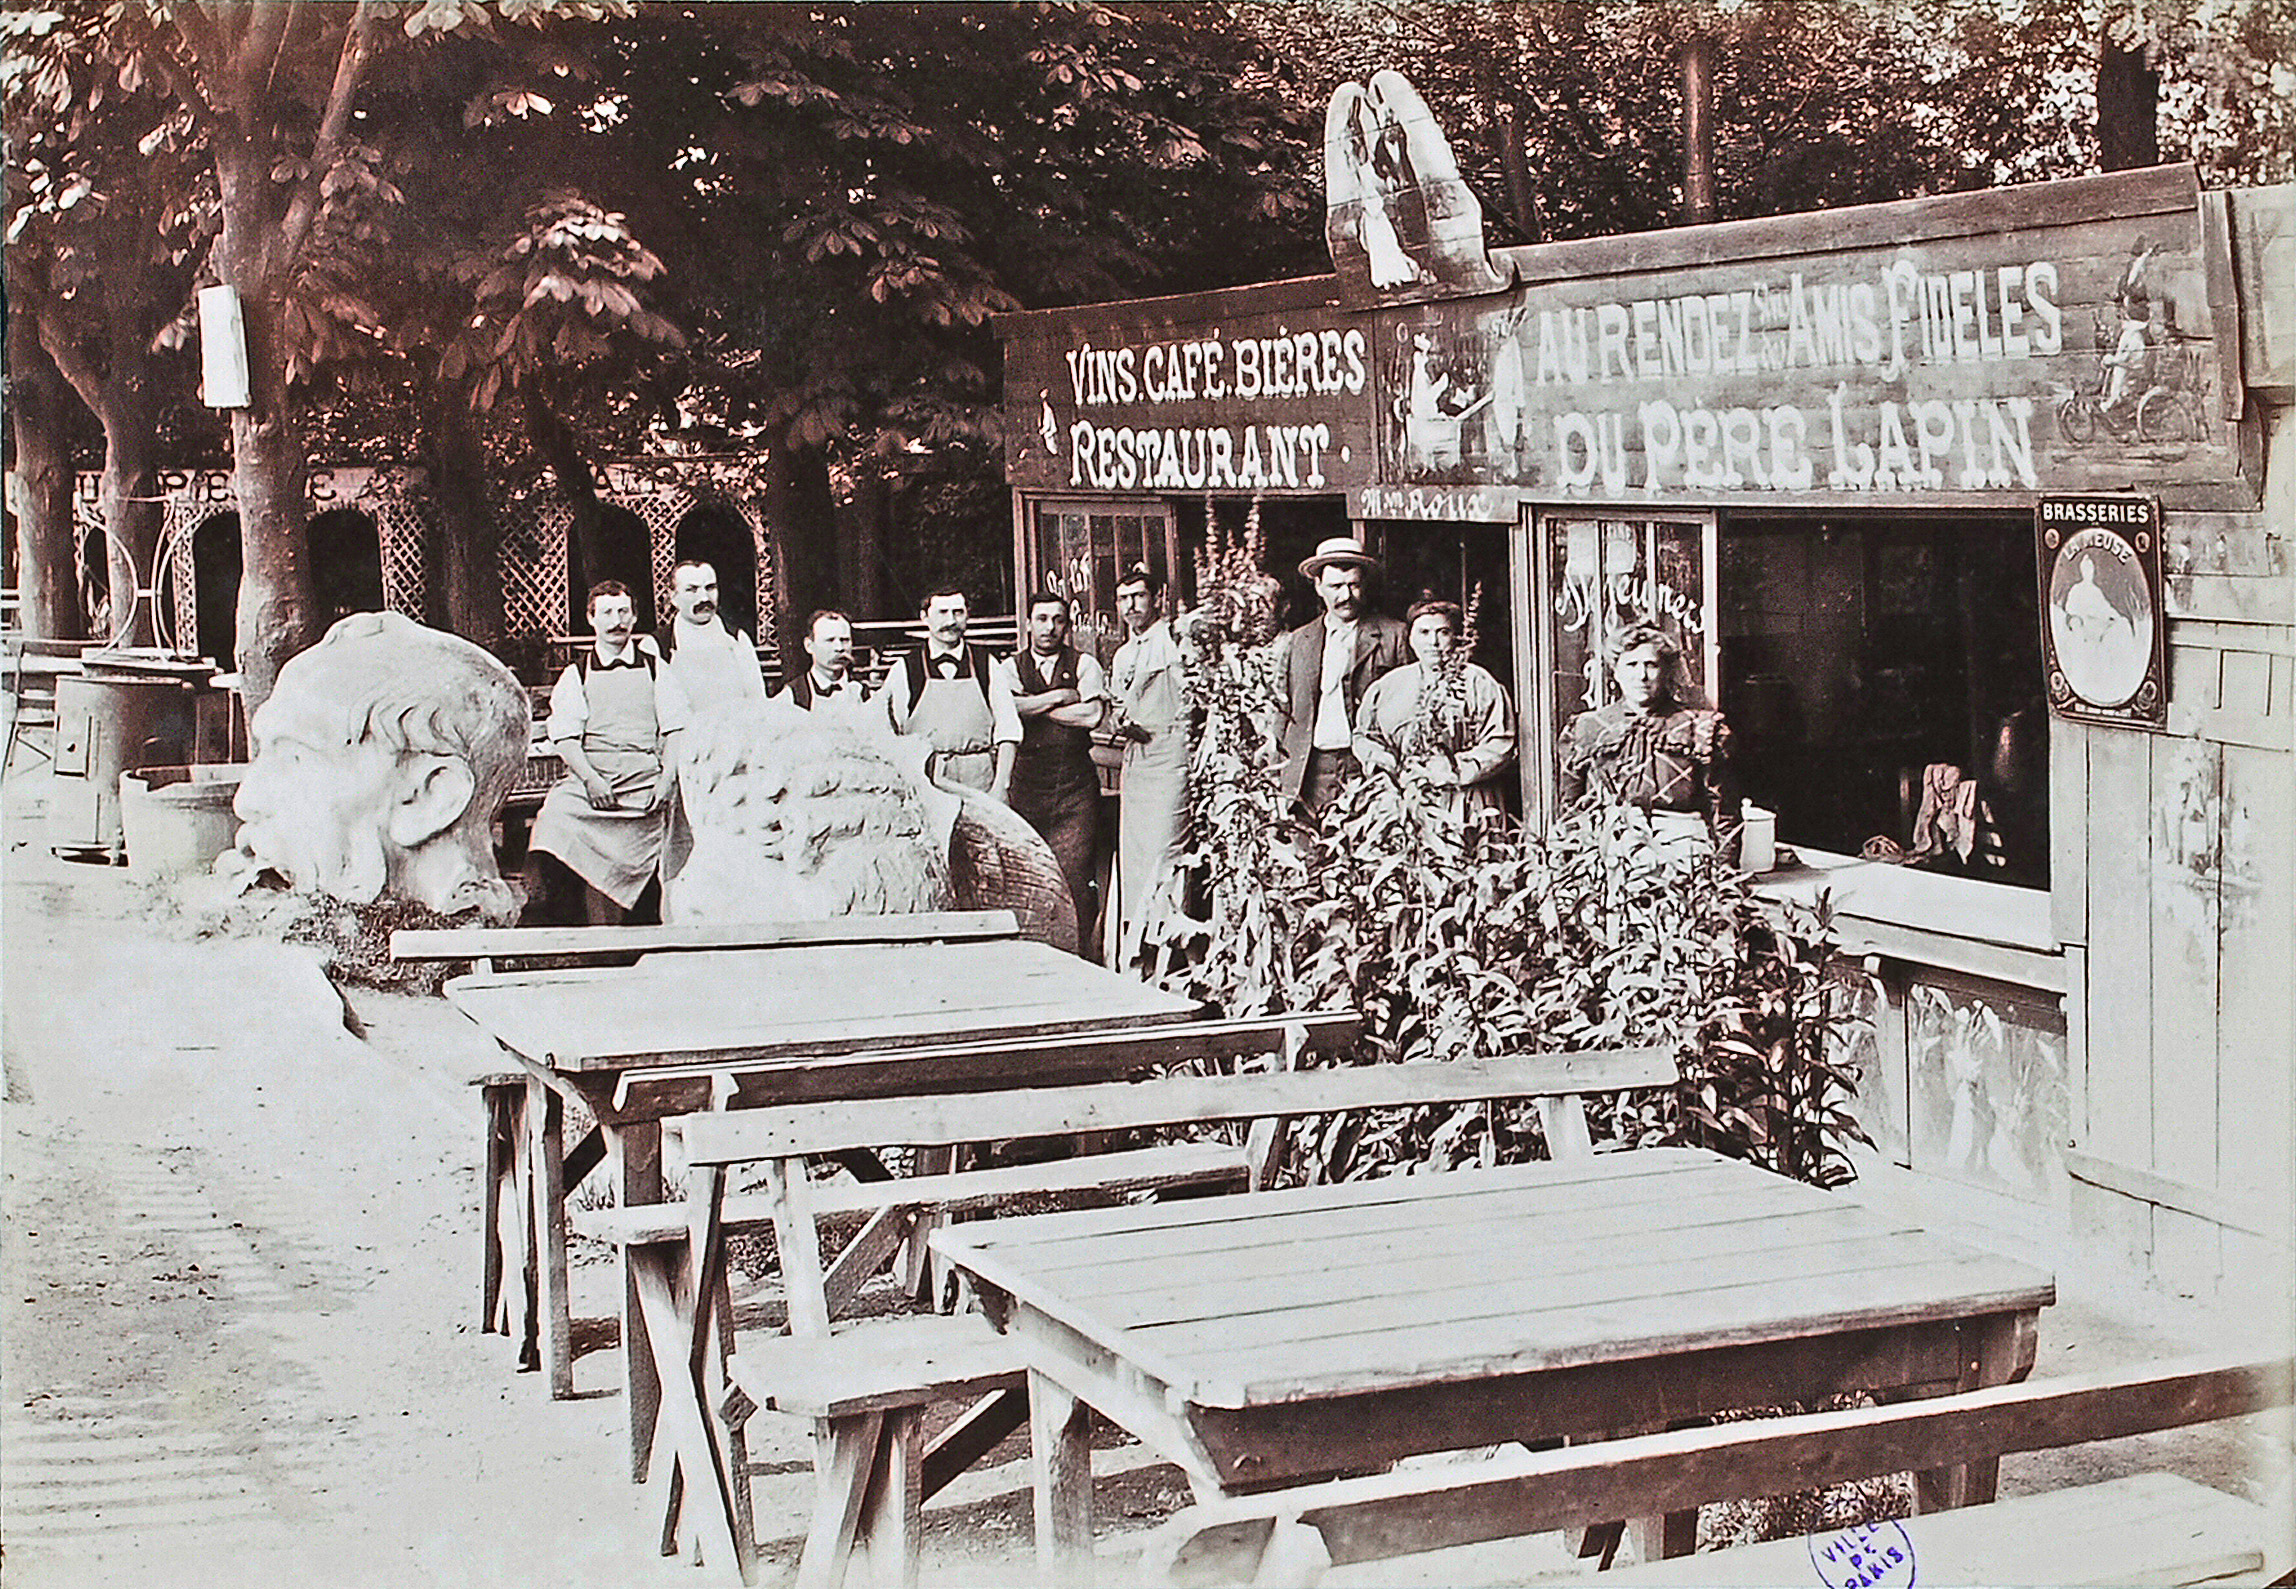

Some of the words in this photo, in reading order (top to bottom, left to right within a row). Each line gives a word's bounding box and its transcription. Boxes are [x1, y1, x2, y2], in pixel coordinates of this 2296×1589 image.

[1536, 307, 1588, 386] AU
[1597, 293, 1758, 384] RENDEZ
[1069, 419, 1331, 489] RESTAURANT
[1553, 412, 1626, 497] DU
[1828, 381, 2038, 492] LAPIN
[2042, 502, 2149, 523] BRASSERIES
